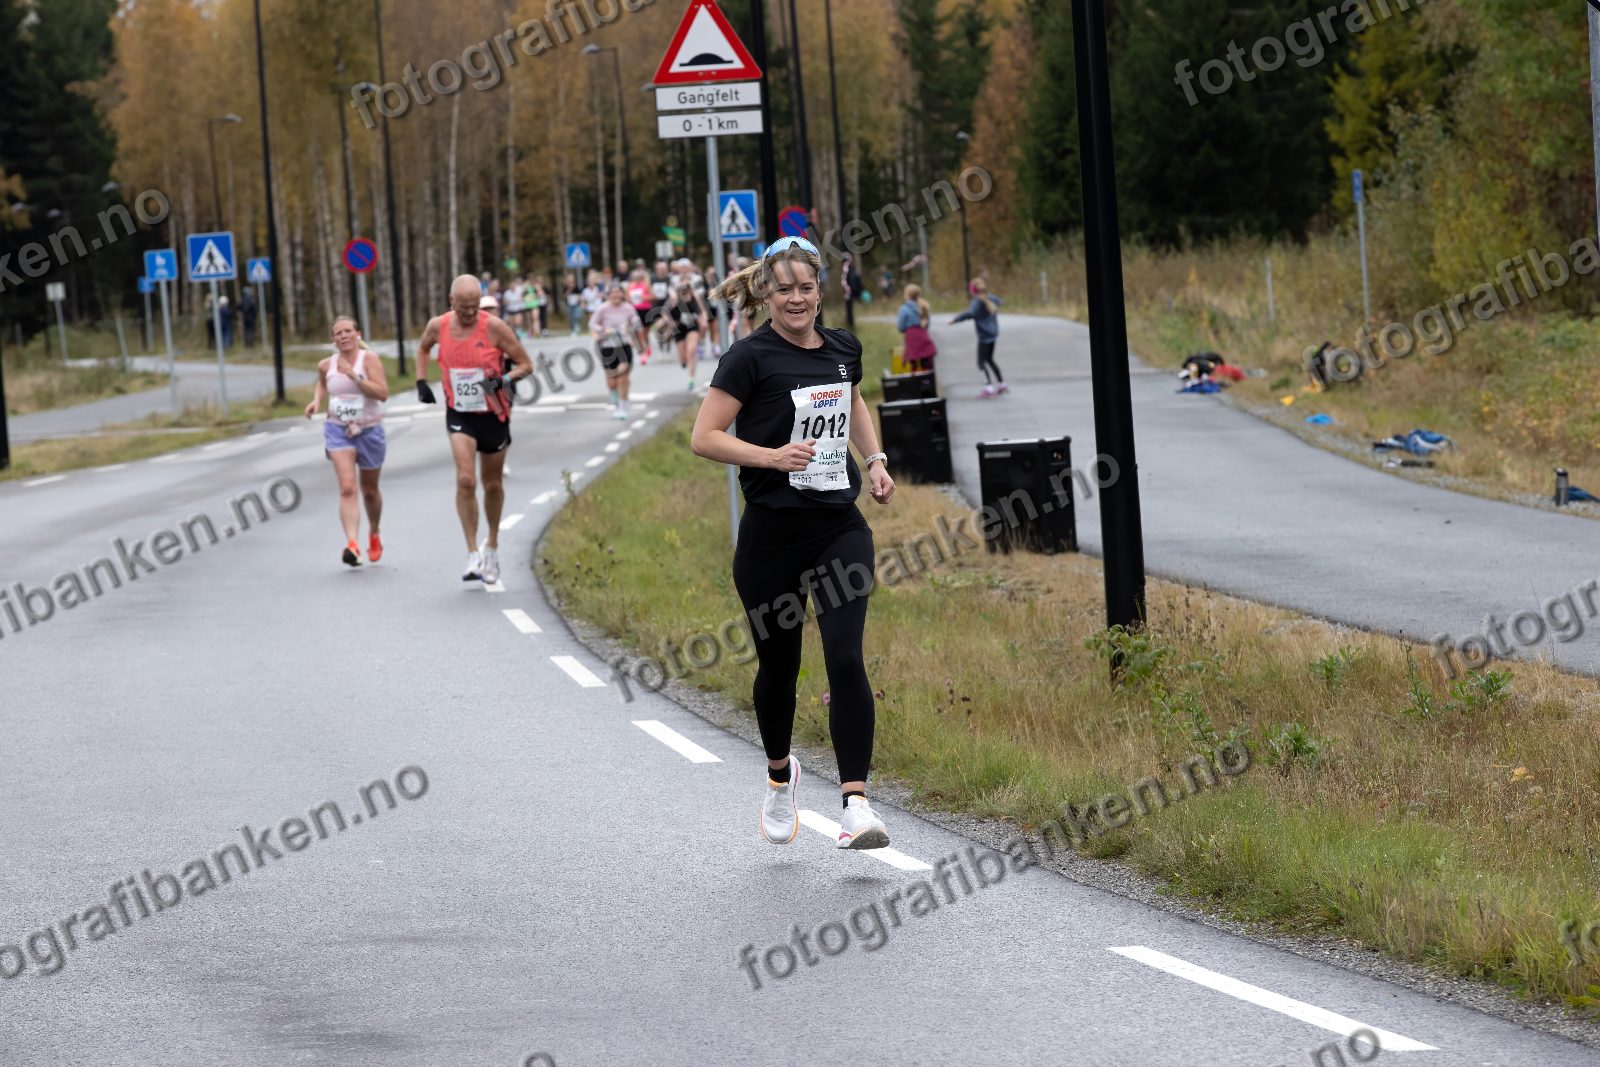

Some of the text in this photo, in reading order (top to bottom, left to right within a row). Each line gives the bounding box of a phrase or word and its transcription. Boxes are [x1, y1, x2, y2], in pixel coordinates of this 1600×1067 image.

[677, 88, 740, 105] Gangfelt
[682, 119, 692, 132] 0
[707, 118, 713, 130] 1
[717, 117, 738, 130] km
[810, 389, 843, 401] NORGES
[813, 398, 838, 408] LØPET
[801, 412, 847, 440] 1012
